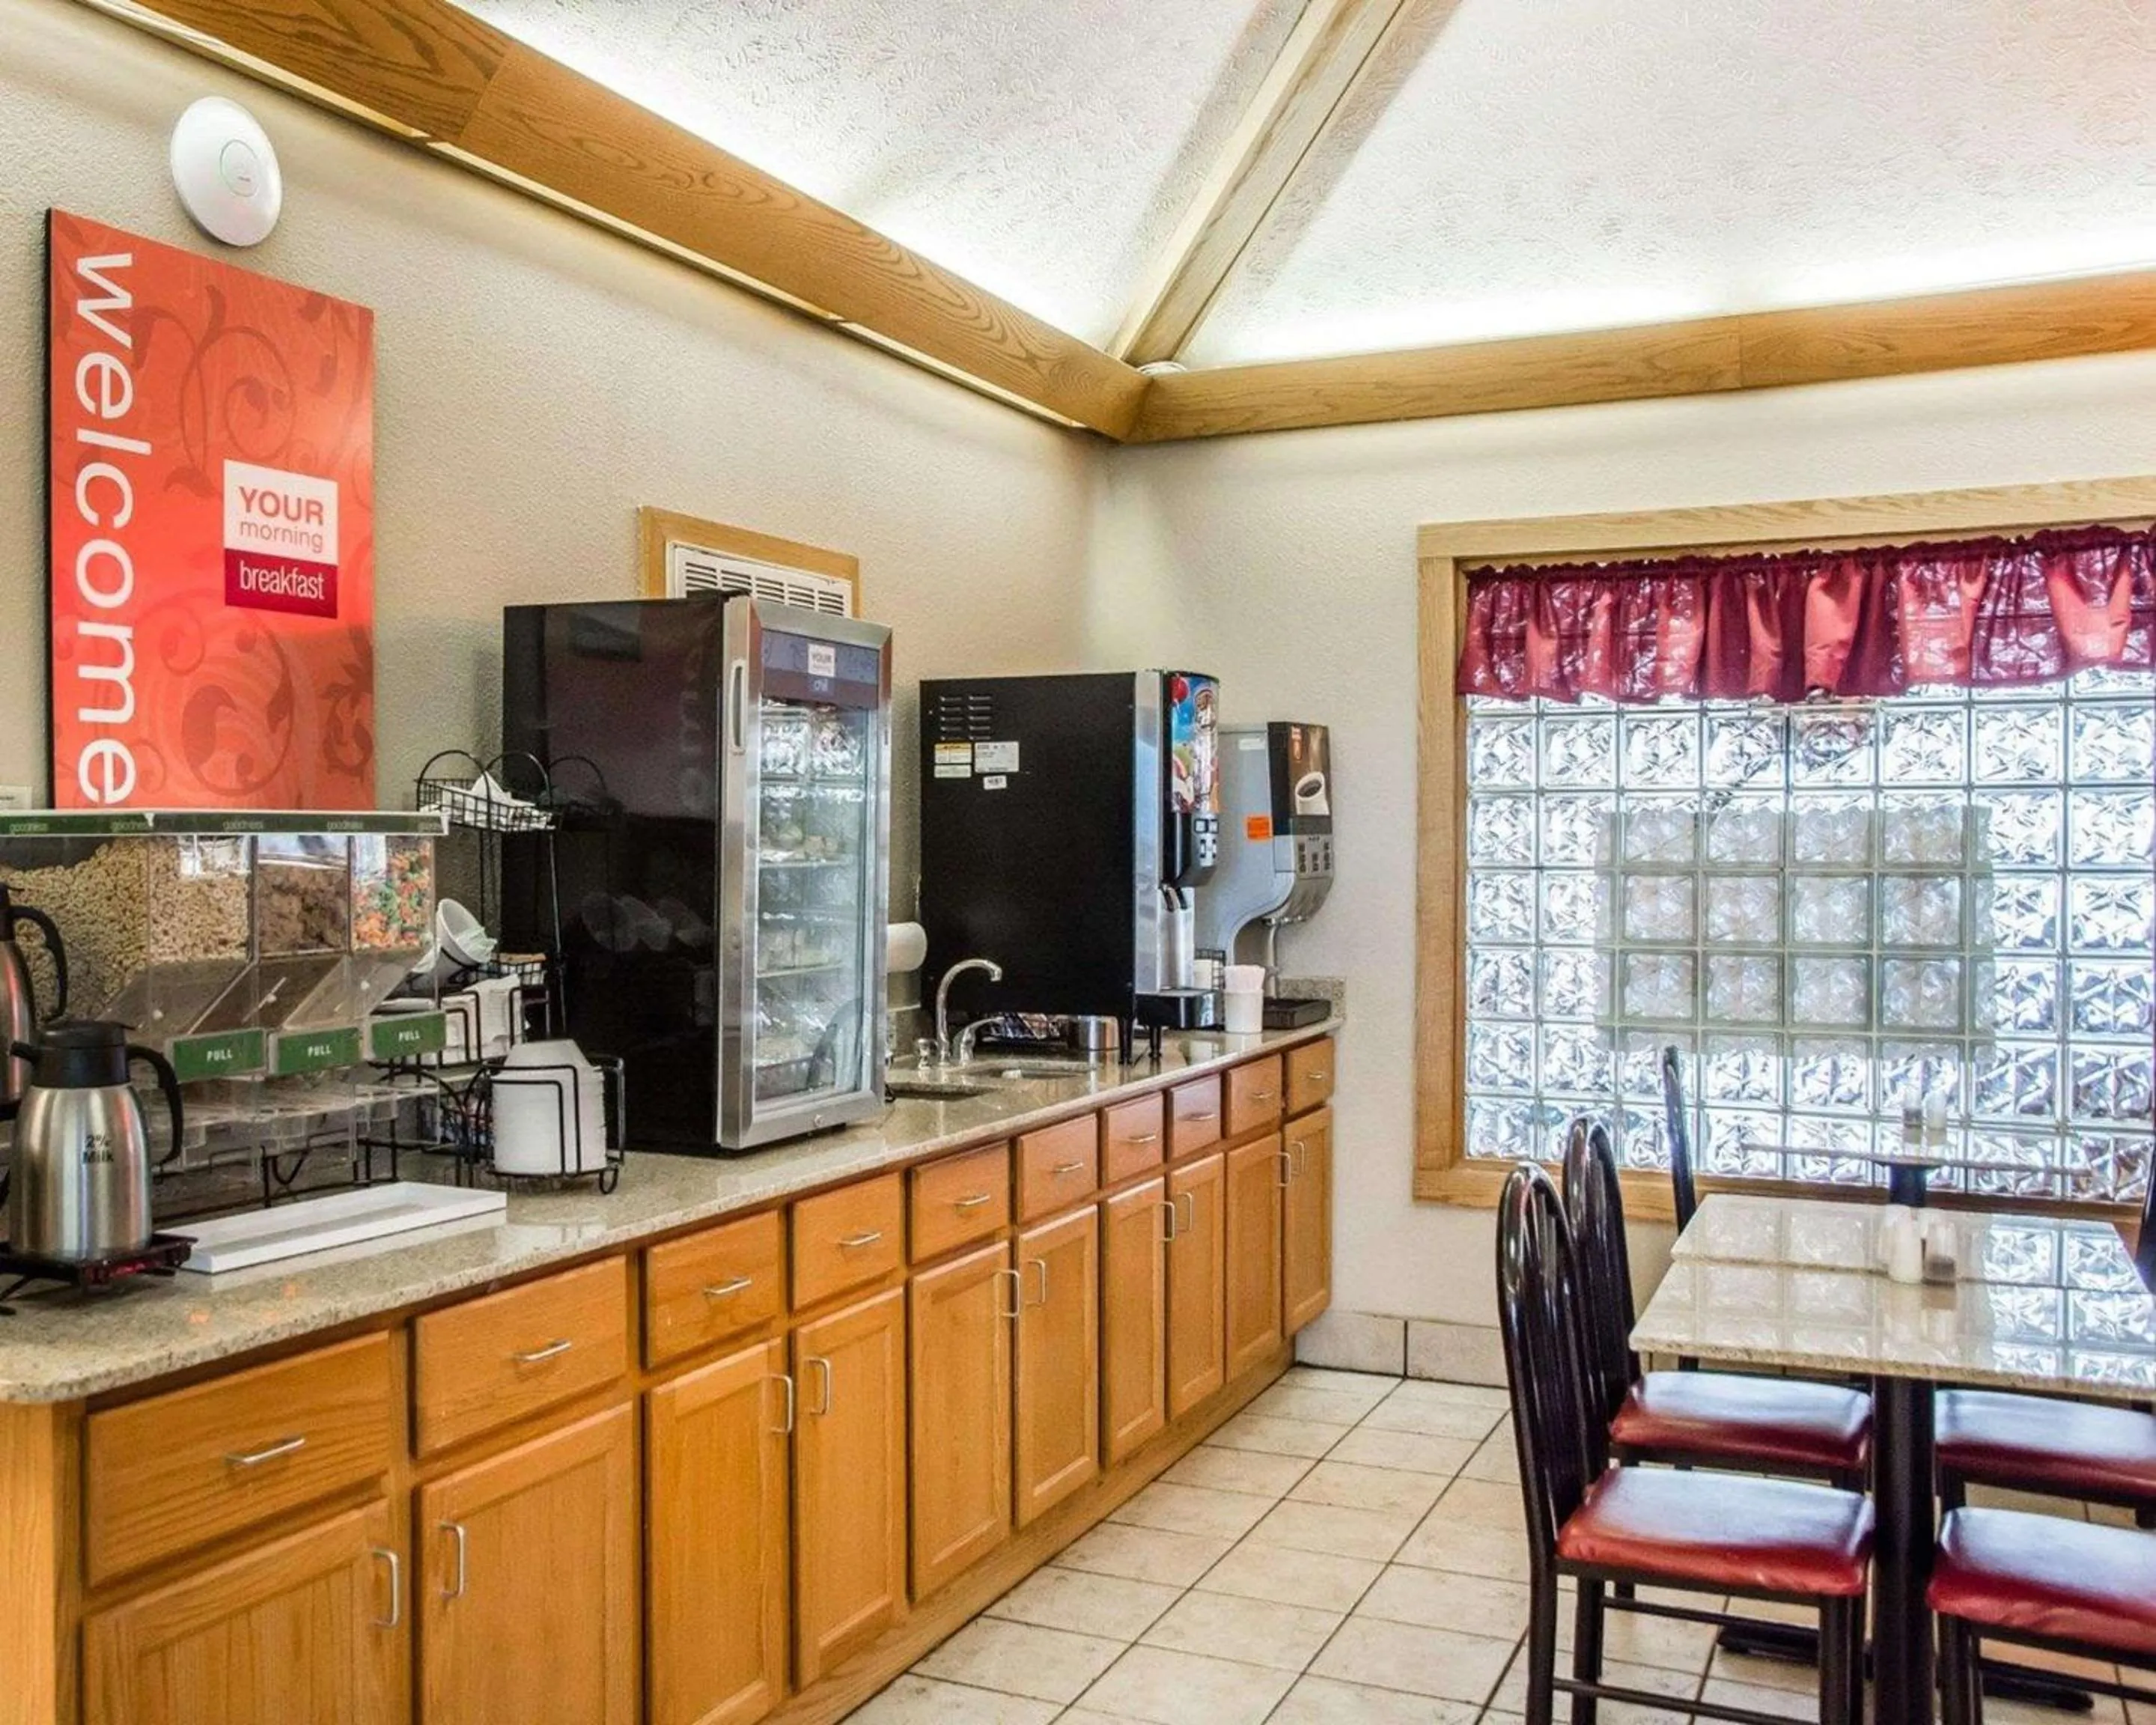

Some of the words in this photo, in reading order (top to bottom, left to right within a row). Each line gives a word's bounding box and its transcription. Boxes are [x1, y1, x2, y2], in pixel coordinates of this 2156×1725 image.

[239, 487, 324, 526] YOUR
[76, 252, 152, 804] welcome
[240, 520, 324, 554] morning
[239, 560, 326, 600] breakfast
[398, 1030, 421, 1041] PULL
[207, 1049, 233, 1061] PULL
[308, 1044, 332, 1057] PULL
[82, 1150, 115, 1163] Milk
